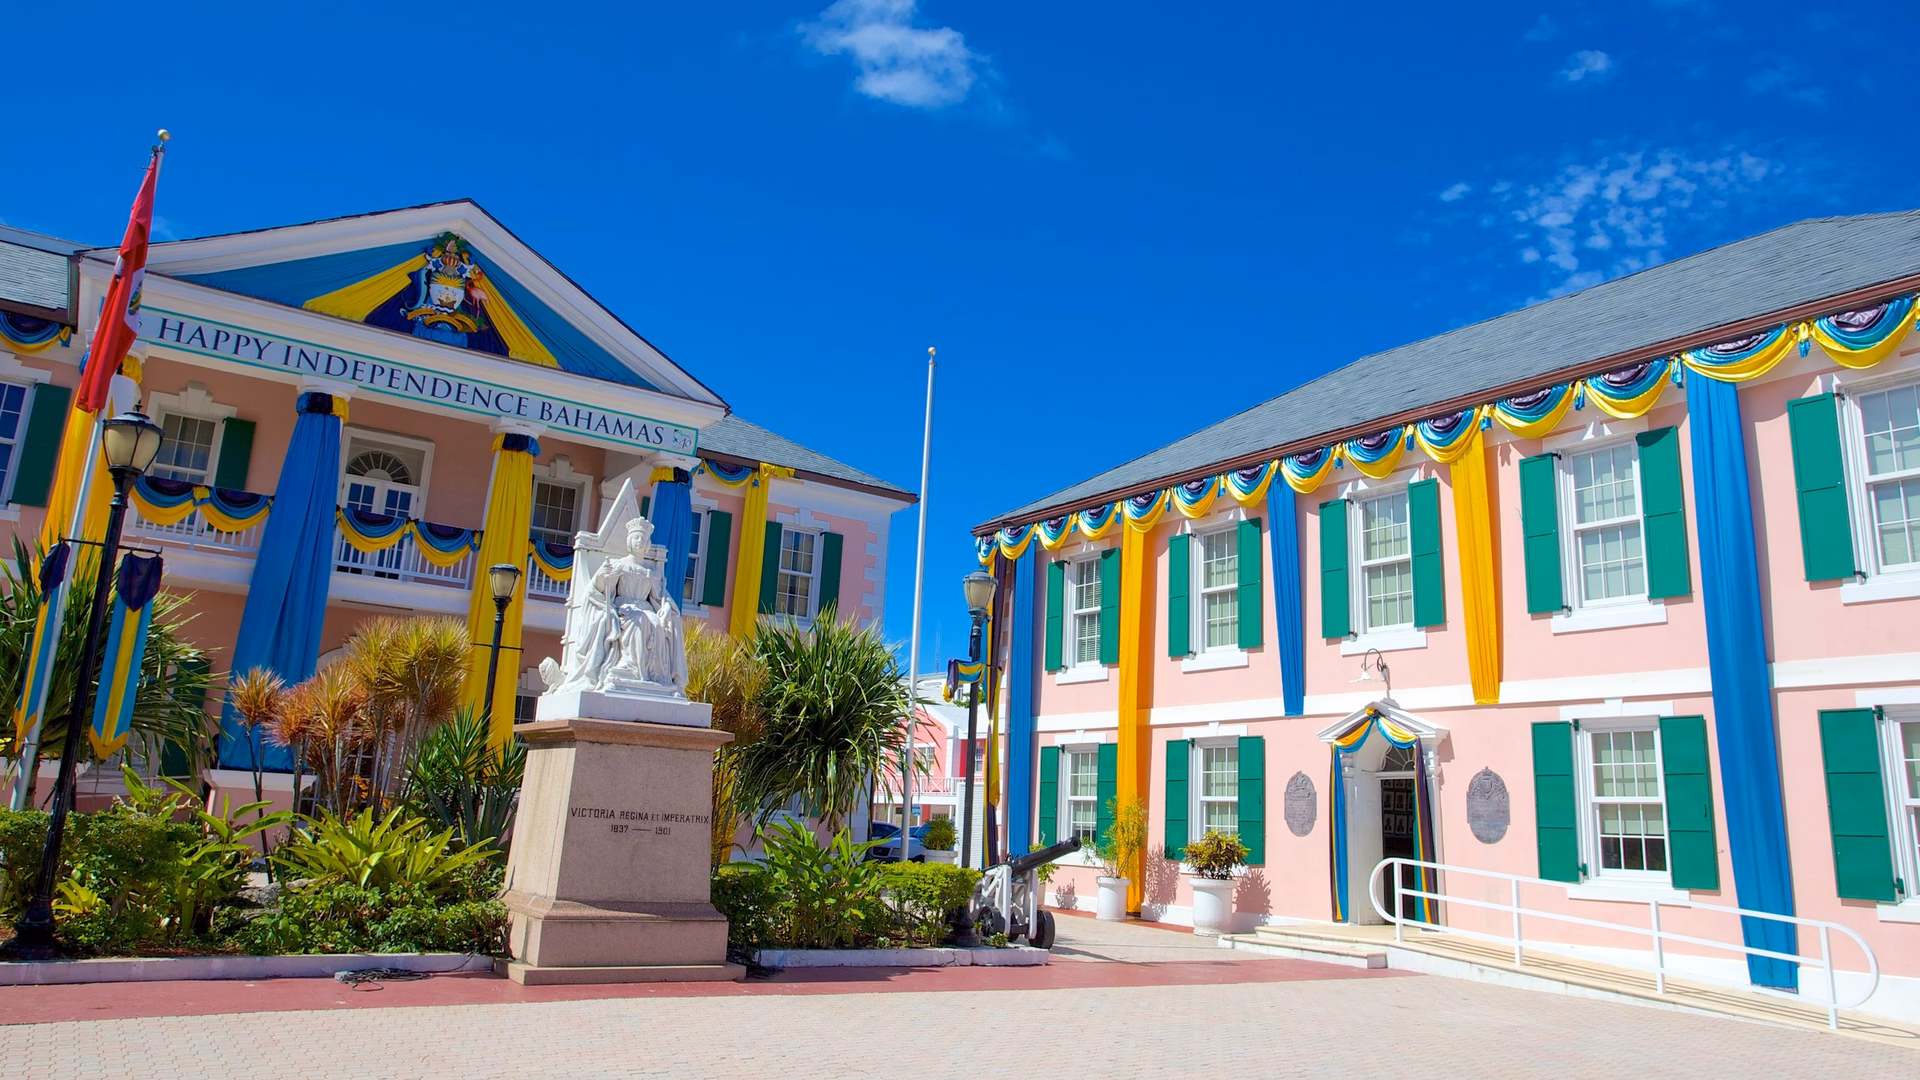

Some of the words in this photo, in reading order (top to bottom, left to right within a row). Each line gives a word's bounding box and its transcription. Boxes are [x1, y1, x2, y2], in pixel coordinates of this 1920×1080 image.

[158, 317, 274, 360] HAPPY
[283, 345, 529, 417] INDEPENDENCE
[539, 401, 665, 445] BAHAMAS
[571, 807, 616, 819] VICTORIA
[619, 811, 649, 821] REGINA
[651, 813, 660, 822] ET
[661, 814, 710, 824] IMPERATRIX
[610, 824, 629, 834] 1837
[655, 826, 671, 836] 1901
